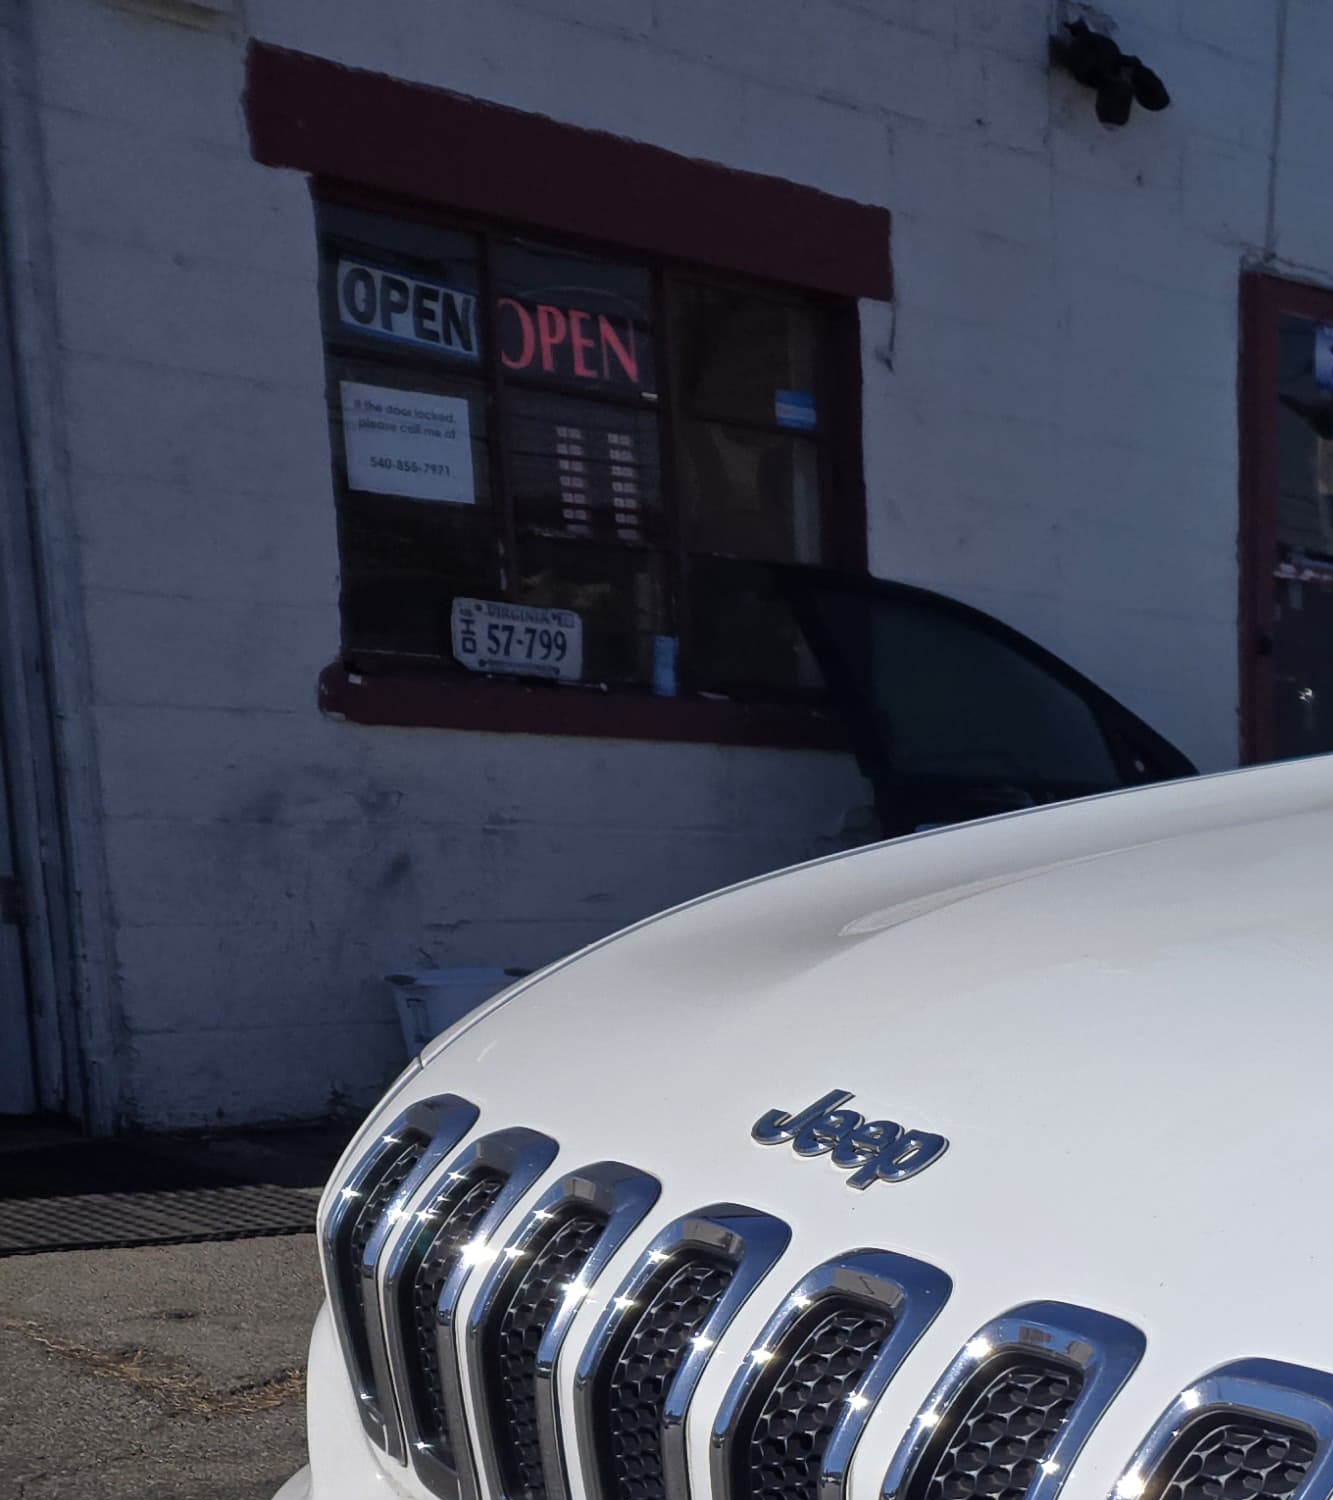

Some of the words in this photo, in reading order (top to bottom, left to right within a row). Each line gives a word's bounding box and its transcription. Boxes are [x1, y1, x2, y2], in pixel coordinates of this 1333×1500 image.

[342, 267, 475, 352] OPEN
[496, 297, 640, 383] OPEN
[487, 623, 567, 662] 57-799
[751, 1088, 950, 1191] Jeep
